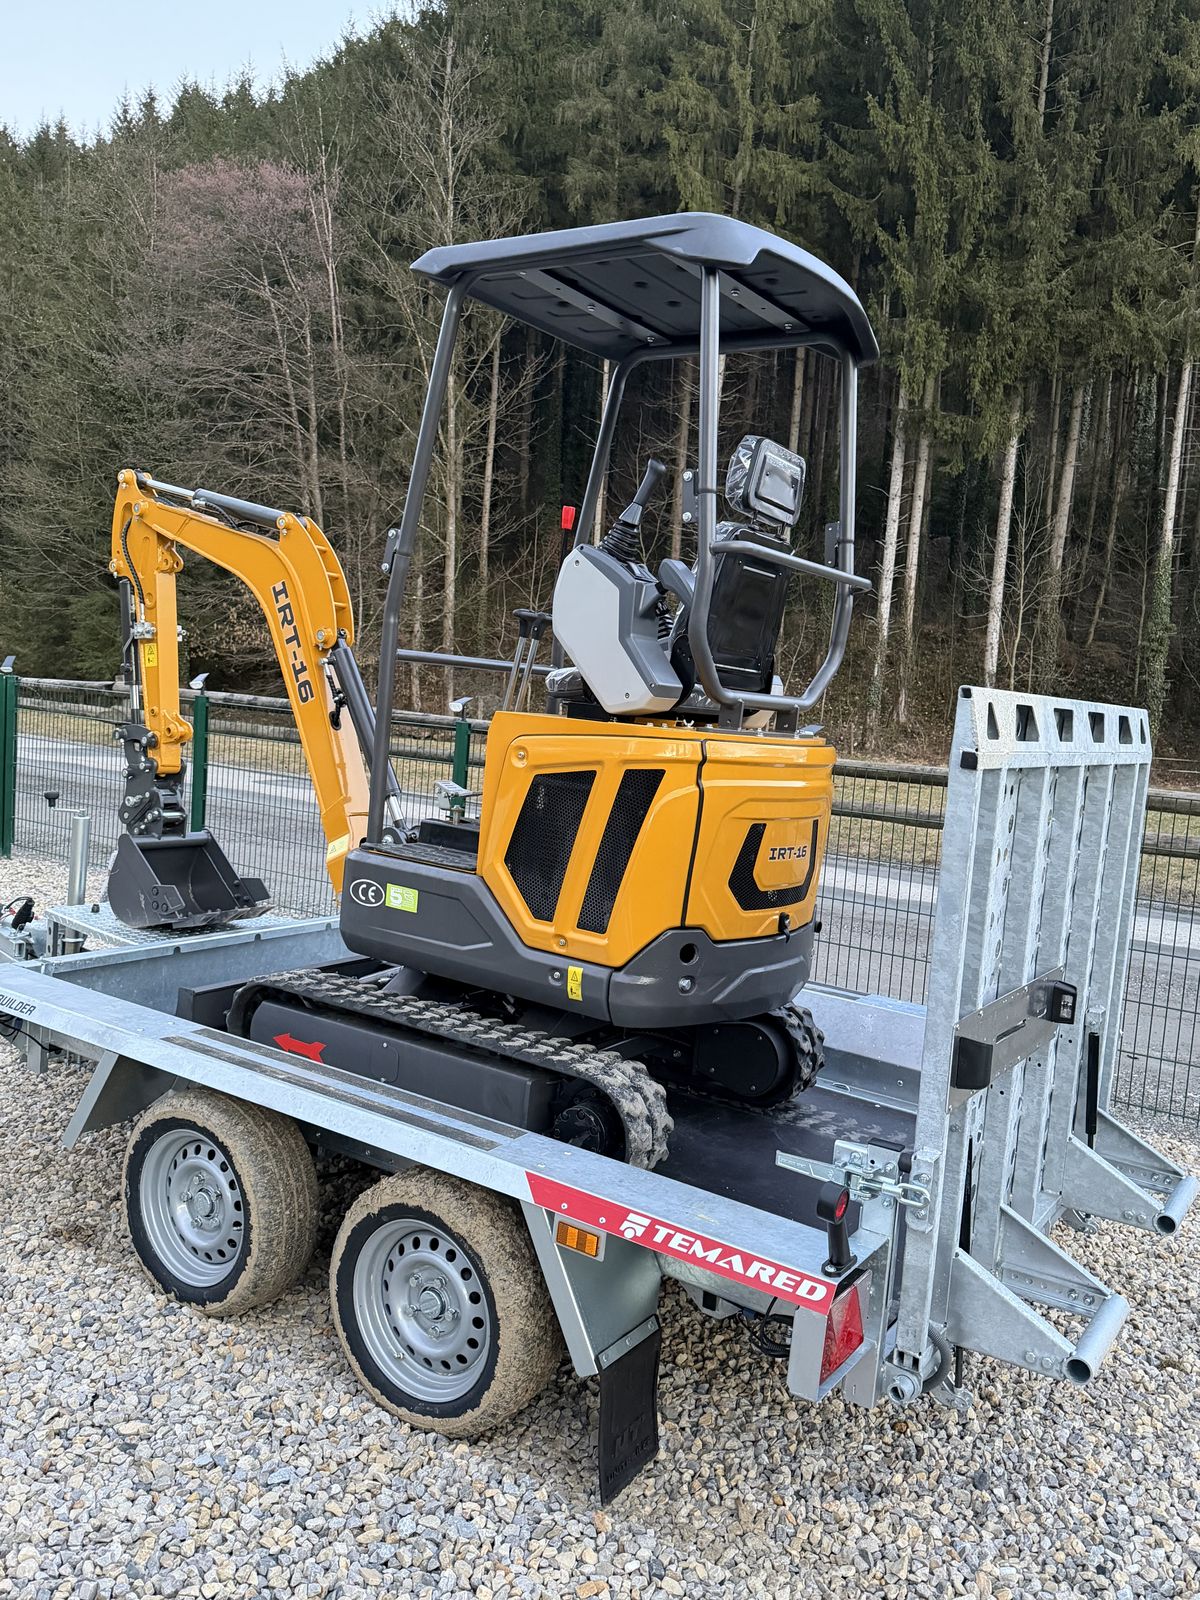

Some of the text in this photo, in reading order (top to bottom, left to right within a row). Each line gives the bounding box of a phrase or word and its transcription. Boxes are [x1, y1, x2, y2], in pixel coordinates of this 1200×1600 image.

[272, 581, 315, 704] IRT-16
[768, 845, 807, 860] IRT-16
[359, 884, 377, 903] CE
[651, 1224, 828, 1301] TEMARED
